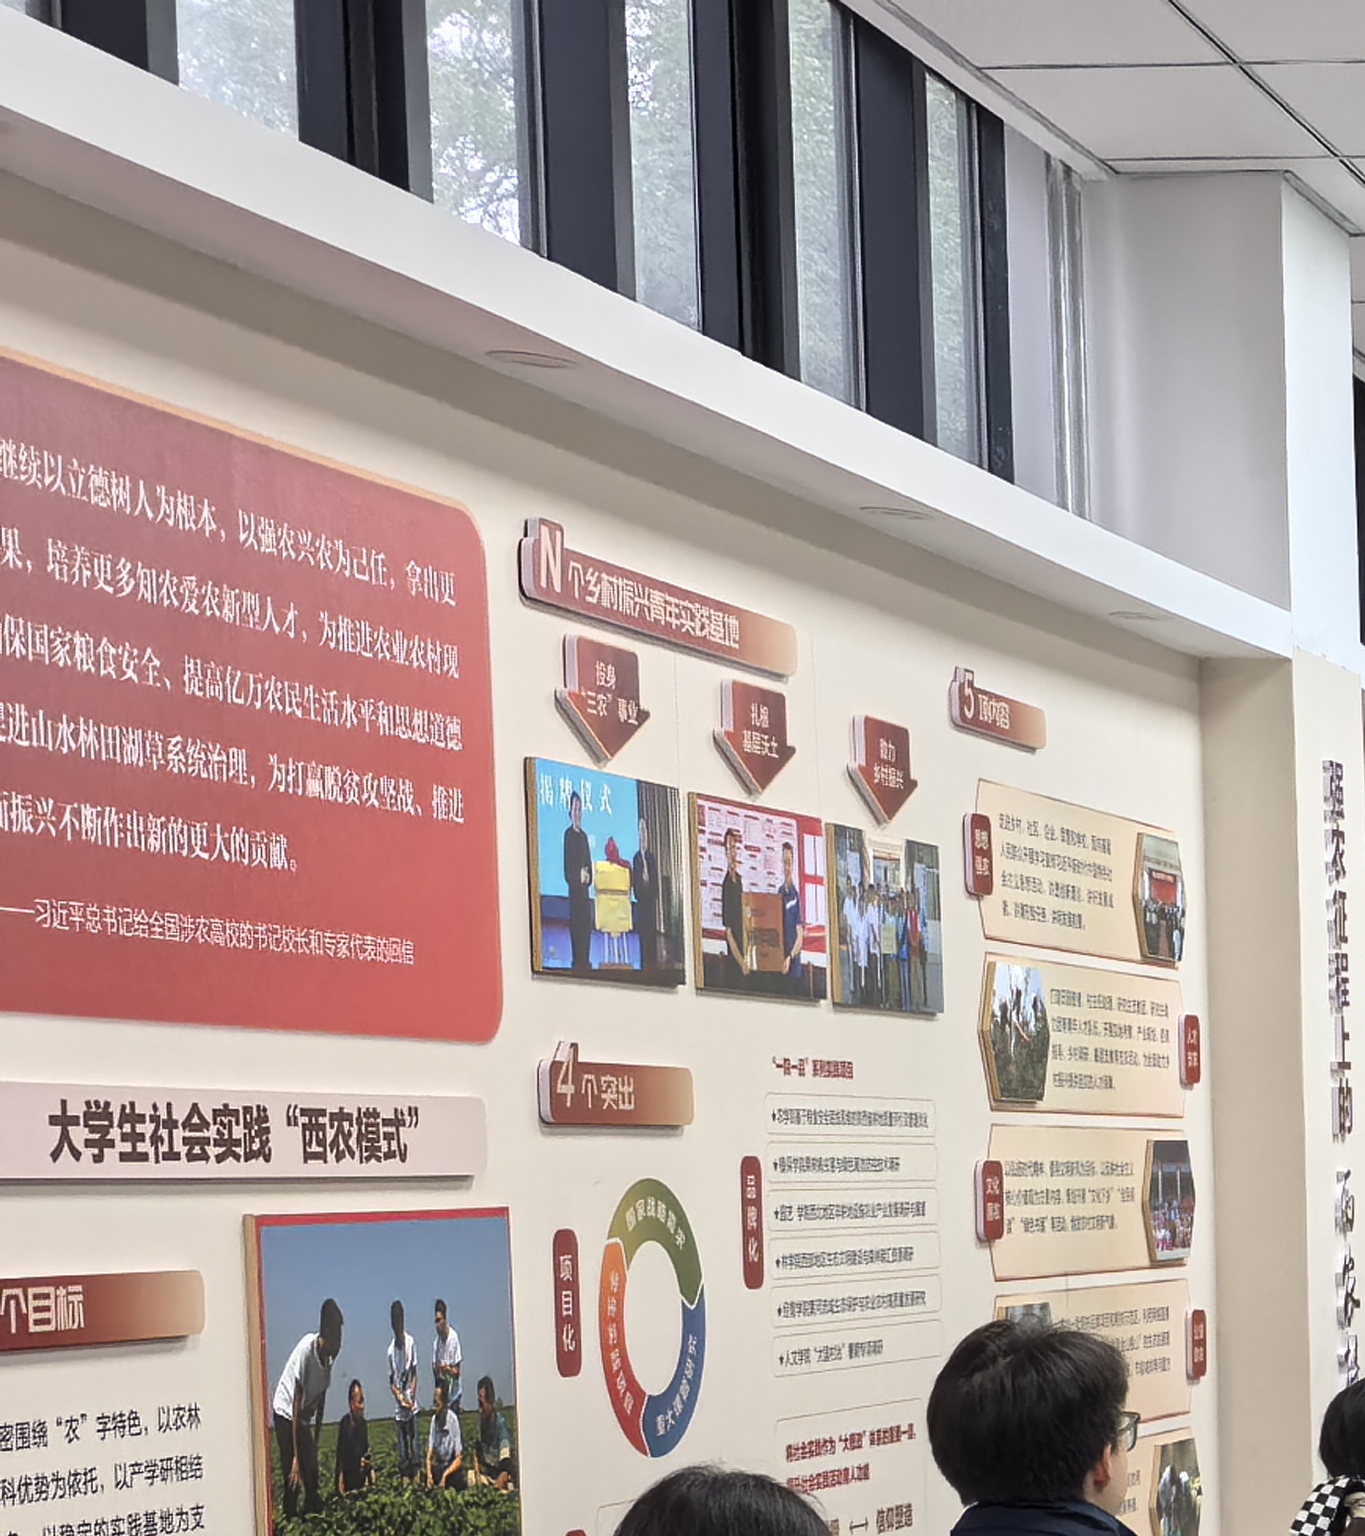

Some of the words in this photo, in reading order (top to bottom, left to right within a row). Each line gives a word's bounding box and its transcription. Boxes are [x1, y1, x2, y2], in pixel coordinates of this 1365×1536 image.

[0, 613, 462, 751] 保国家粮食安全、提高亿万农民生活水平和思想道德
[595, 661, 616, 689] 投身
[557, 1045, 635, 1110] 4个突出
[48, 1099, 419, 1164] 大学生社会实践“西农模式”
[745, 1174, 761, 1263] 品牌化
[0, 1284, 86, 1335] 个目标
[559, 1254, 576, 1352] 项目化
